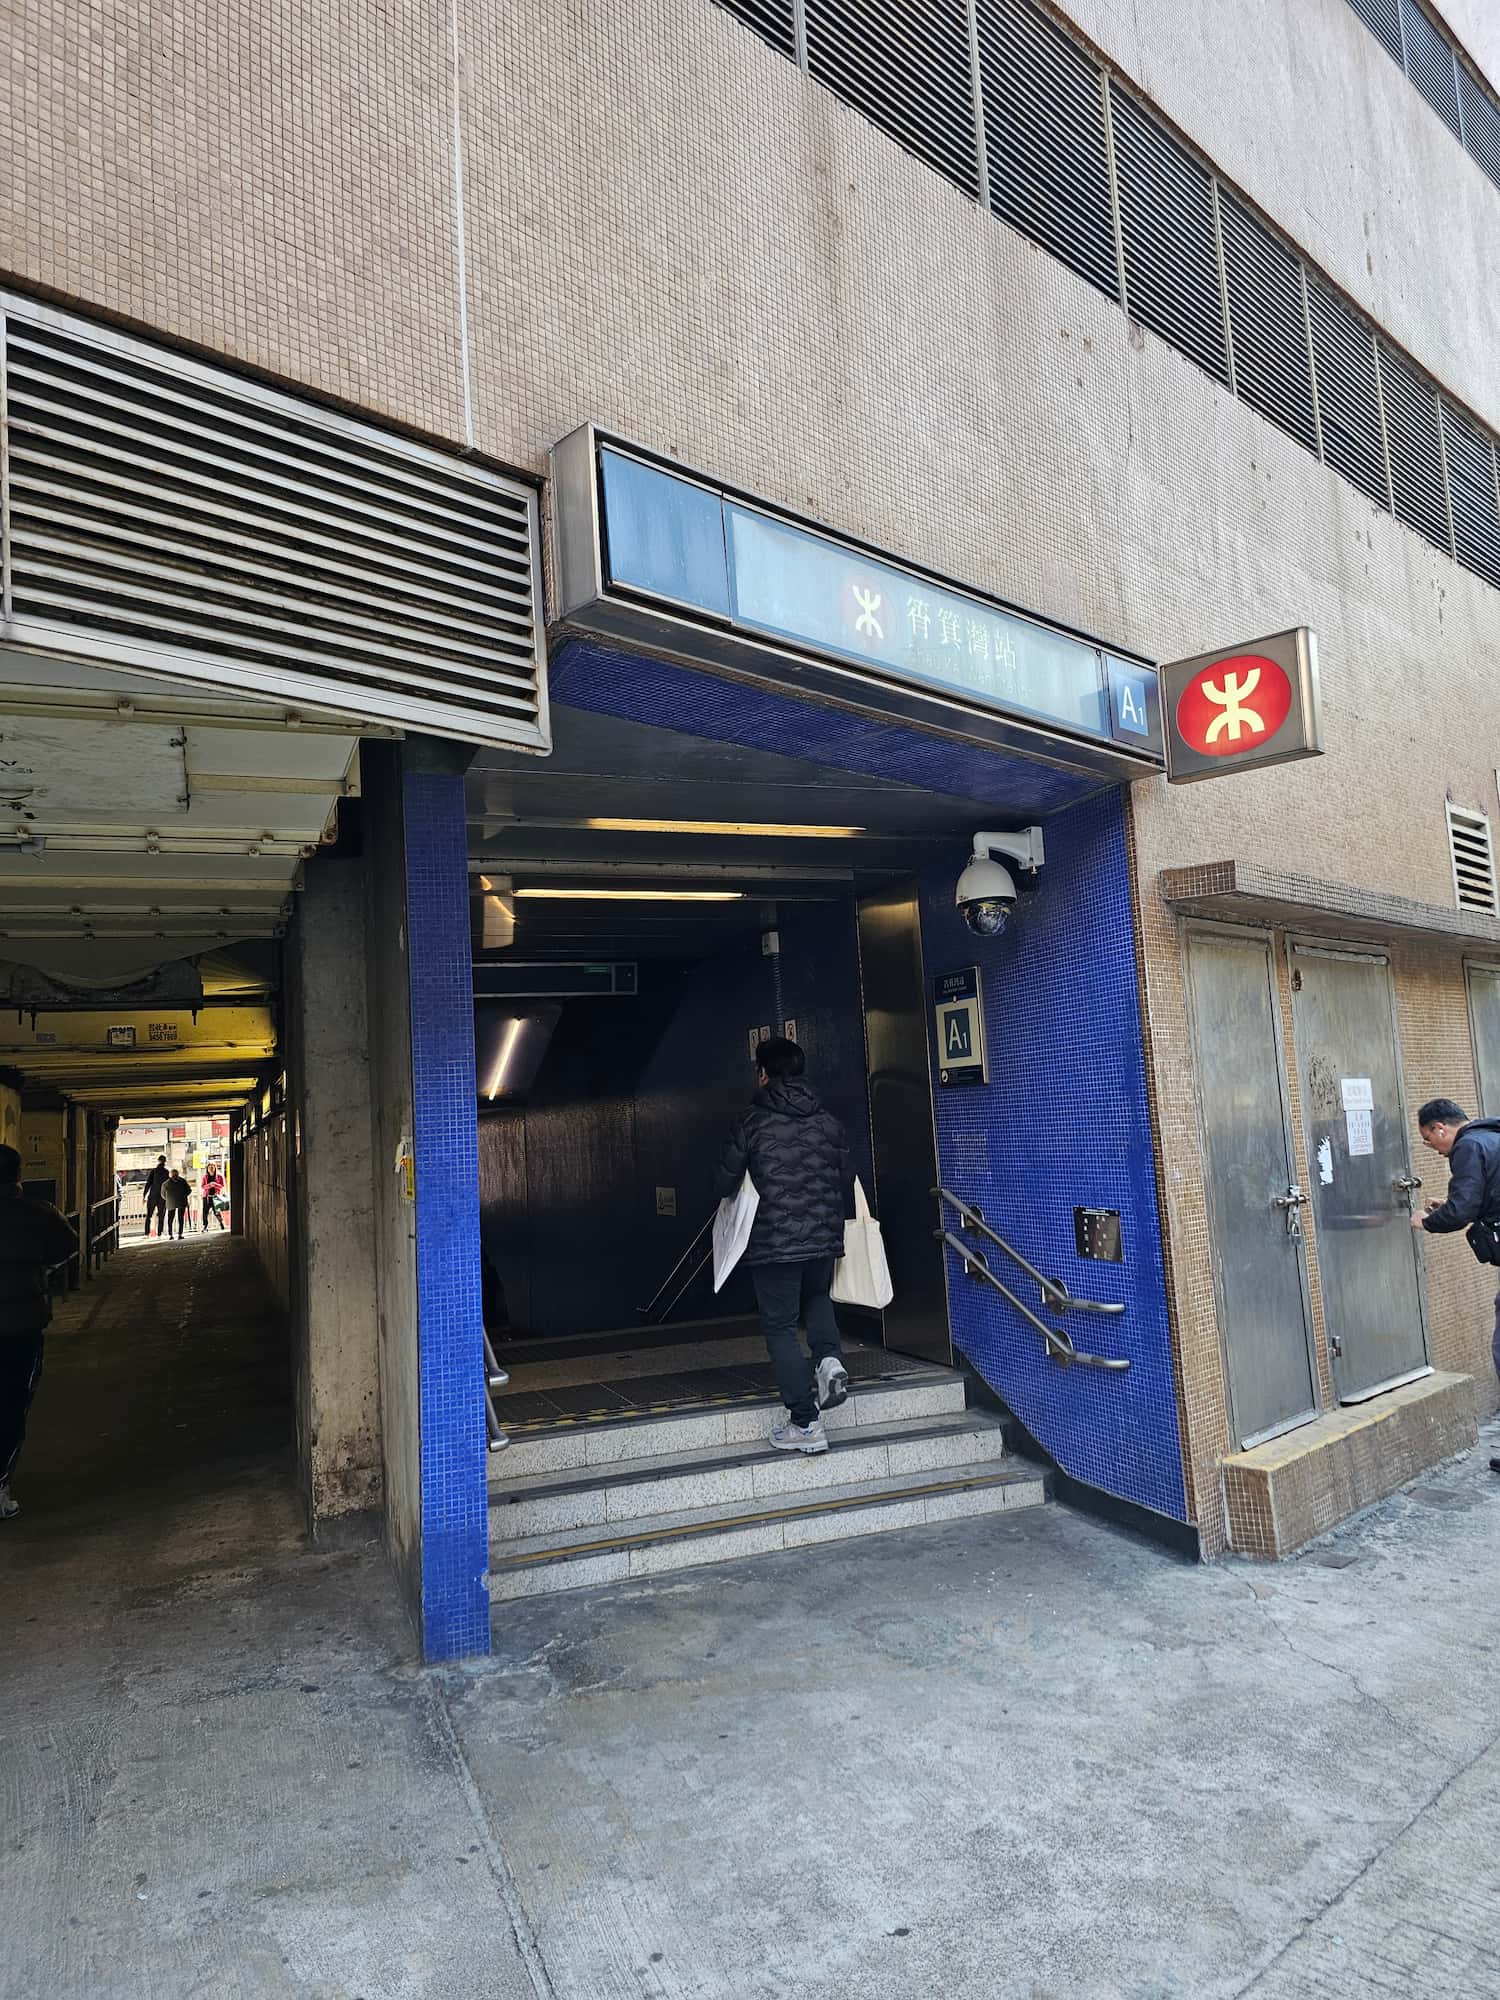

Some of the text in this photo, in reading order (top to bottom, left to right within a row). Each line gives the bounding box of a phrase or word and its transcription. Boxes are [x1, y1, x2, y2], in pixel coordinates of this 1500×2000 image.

[906, 597, 1017, 670] 筲箕灣站
[1121, 685, 1145, 726] A1
[948, 1018, 968, 1051] A1
